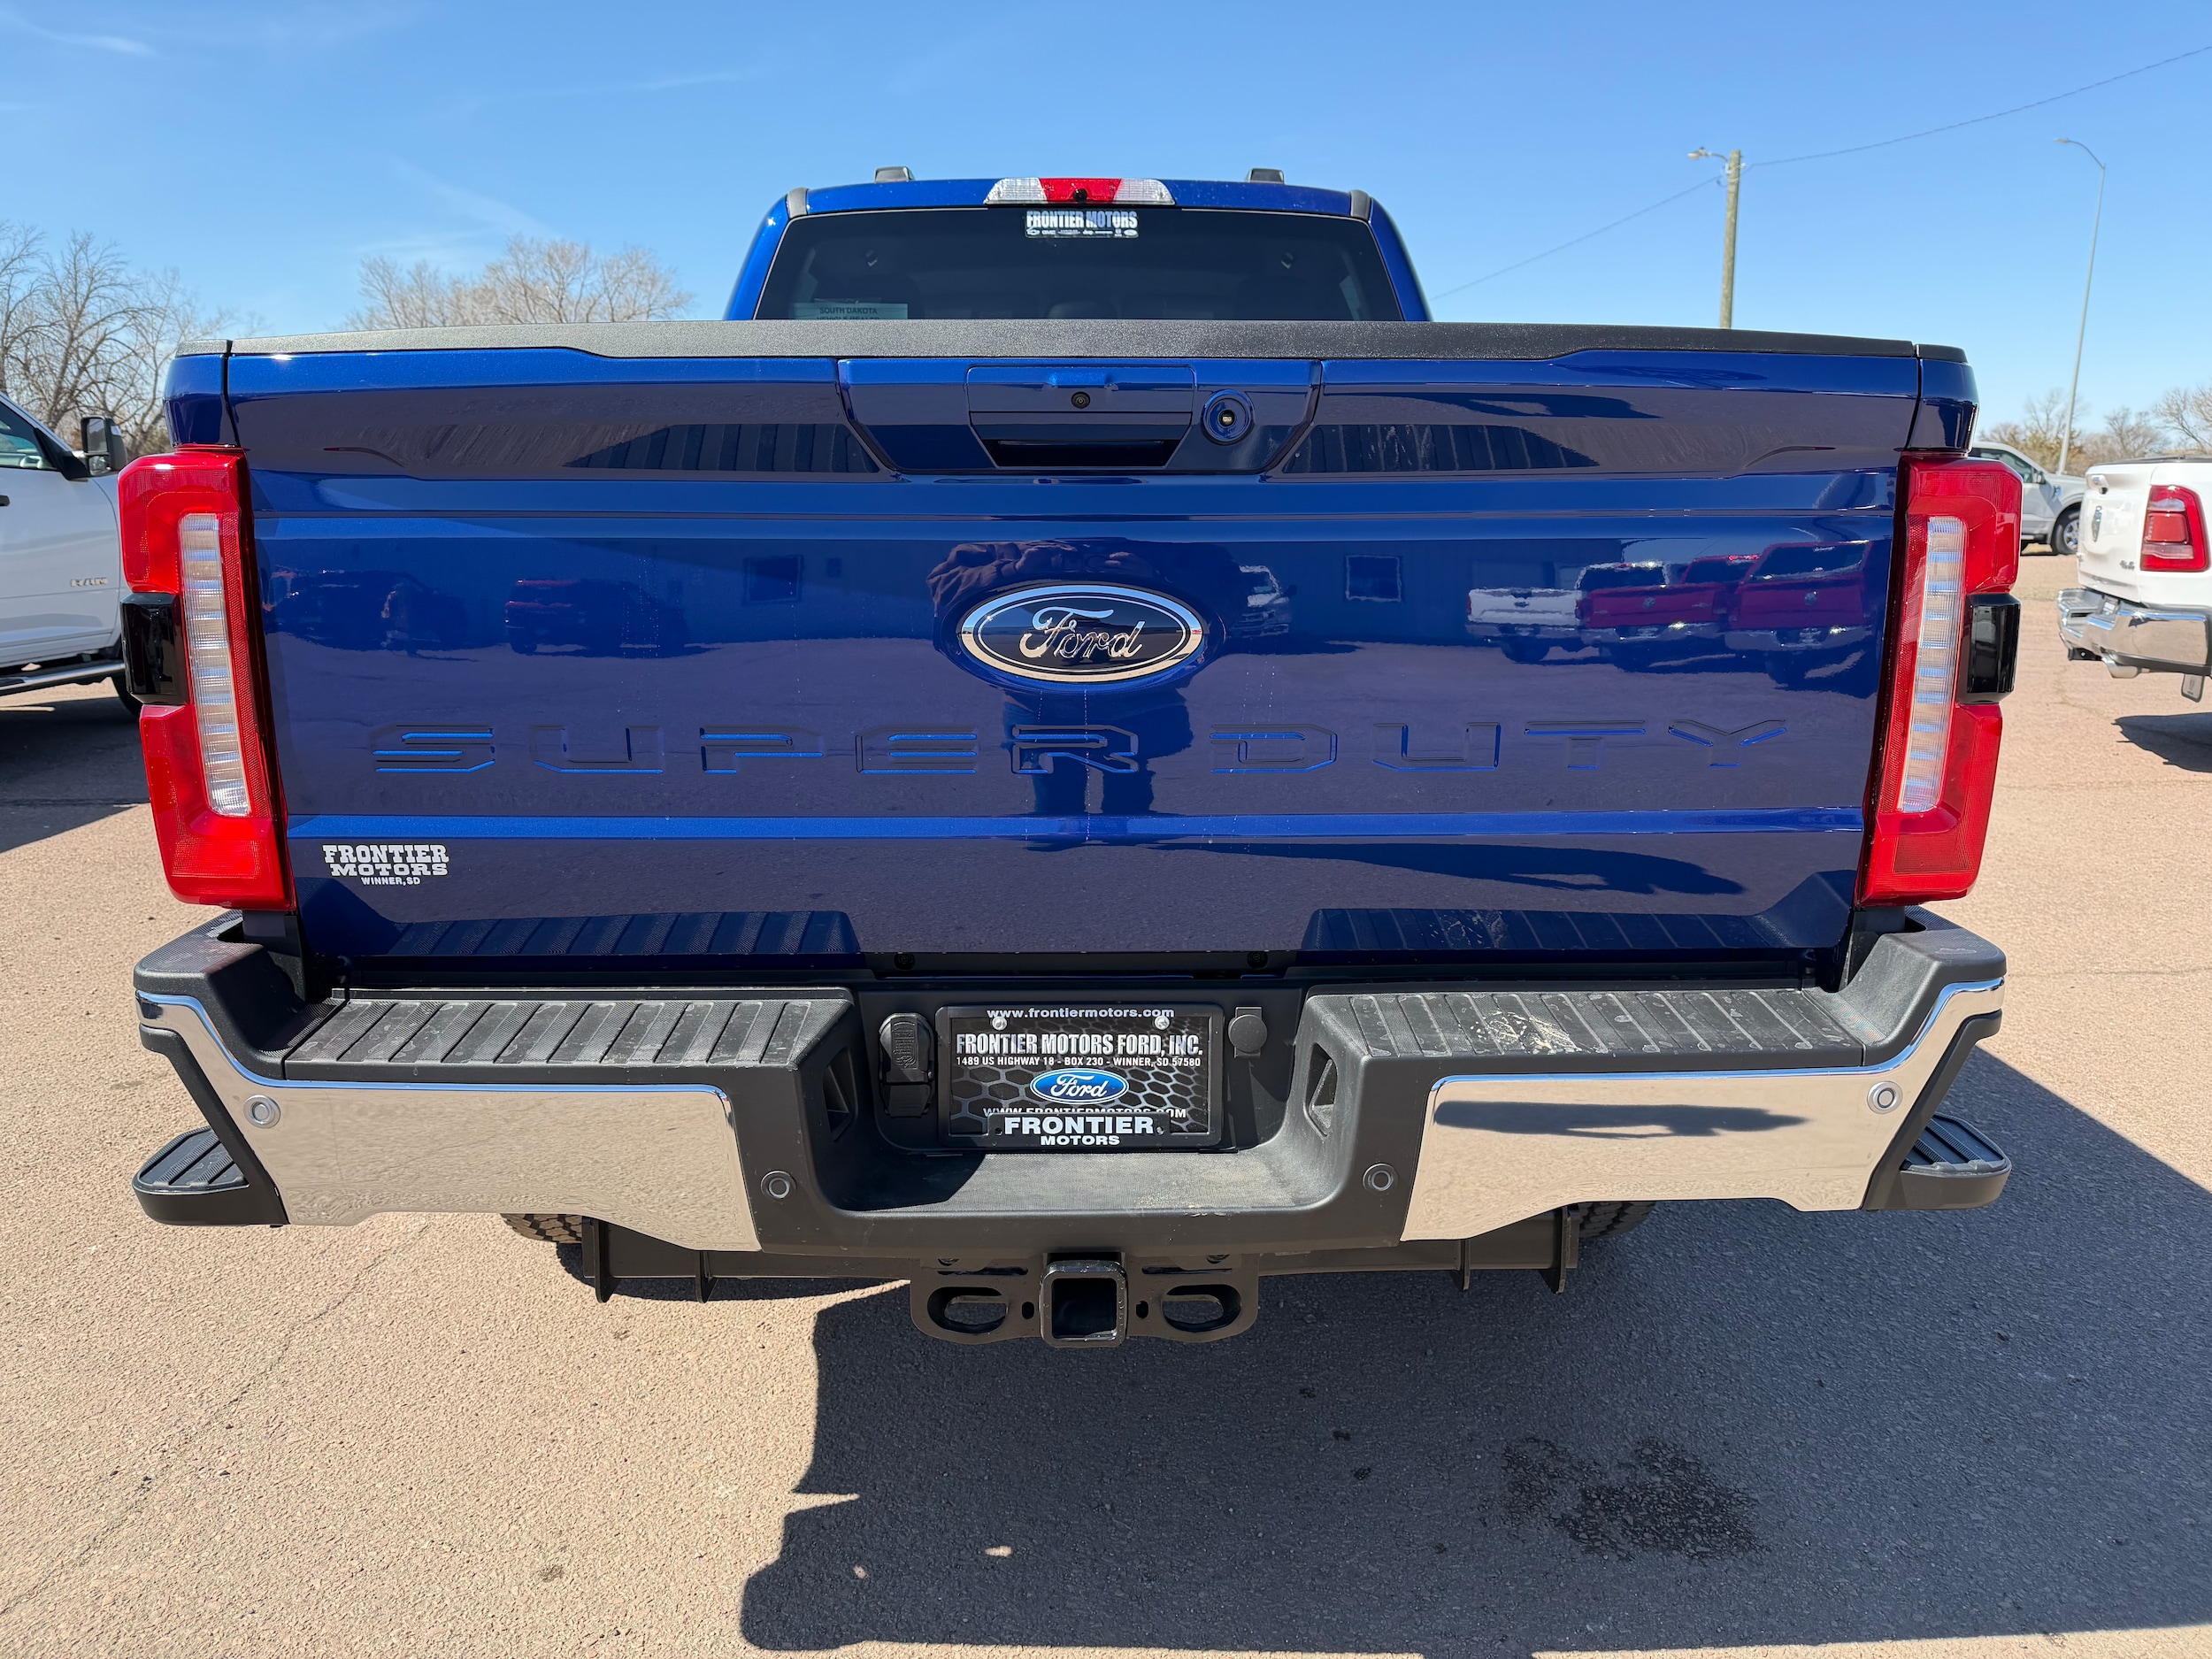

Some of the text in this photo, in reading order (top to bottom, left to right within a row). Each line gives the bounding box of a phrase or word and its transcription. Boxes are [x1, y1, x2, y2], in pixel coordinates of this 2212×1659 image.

[1026, 211, 1138, 228] FRONTIER MOTORS
[1019, 606, 1146, 658] Ford
[370, 718, 1787, 774] SUPER DUTY
[322, 844, 449, 864] FRONTIER
[329, 863, 449, 877] MOTORS
[987, 1007, 1175, 1018] www.frontiermotors.com
[956, 1033, 1203, 1056] FRONTIER MOTORS FORD, INC.
[956, 1056, 979, 1066] 1489
[982, 1056, 995, 1066] US
[997, 1056, 1040, 1066] HIGHWAY
[1043, 1056, 1055, 1066] 18
[1064, 1056, 1084, 1066] BOX
[1086, 1056, 1104, 1066] 230
[1113, 1056, 1154, 1067] WINNER,
[1156, 1057, 1169, 1066] SD
[1171, 1057, 1202, 1066] 57580
[1050, 1073, 1108, 1098] Ford
[1004, 1117, 1154, 1135] FRONTIER
[1040, 1135, 1121, 1146] MOTORS
